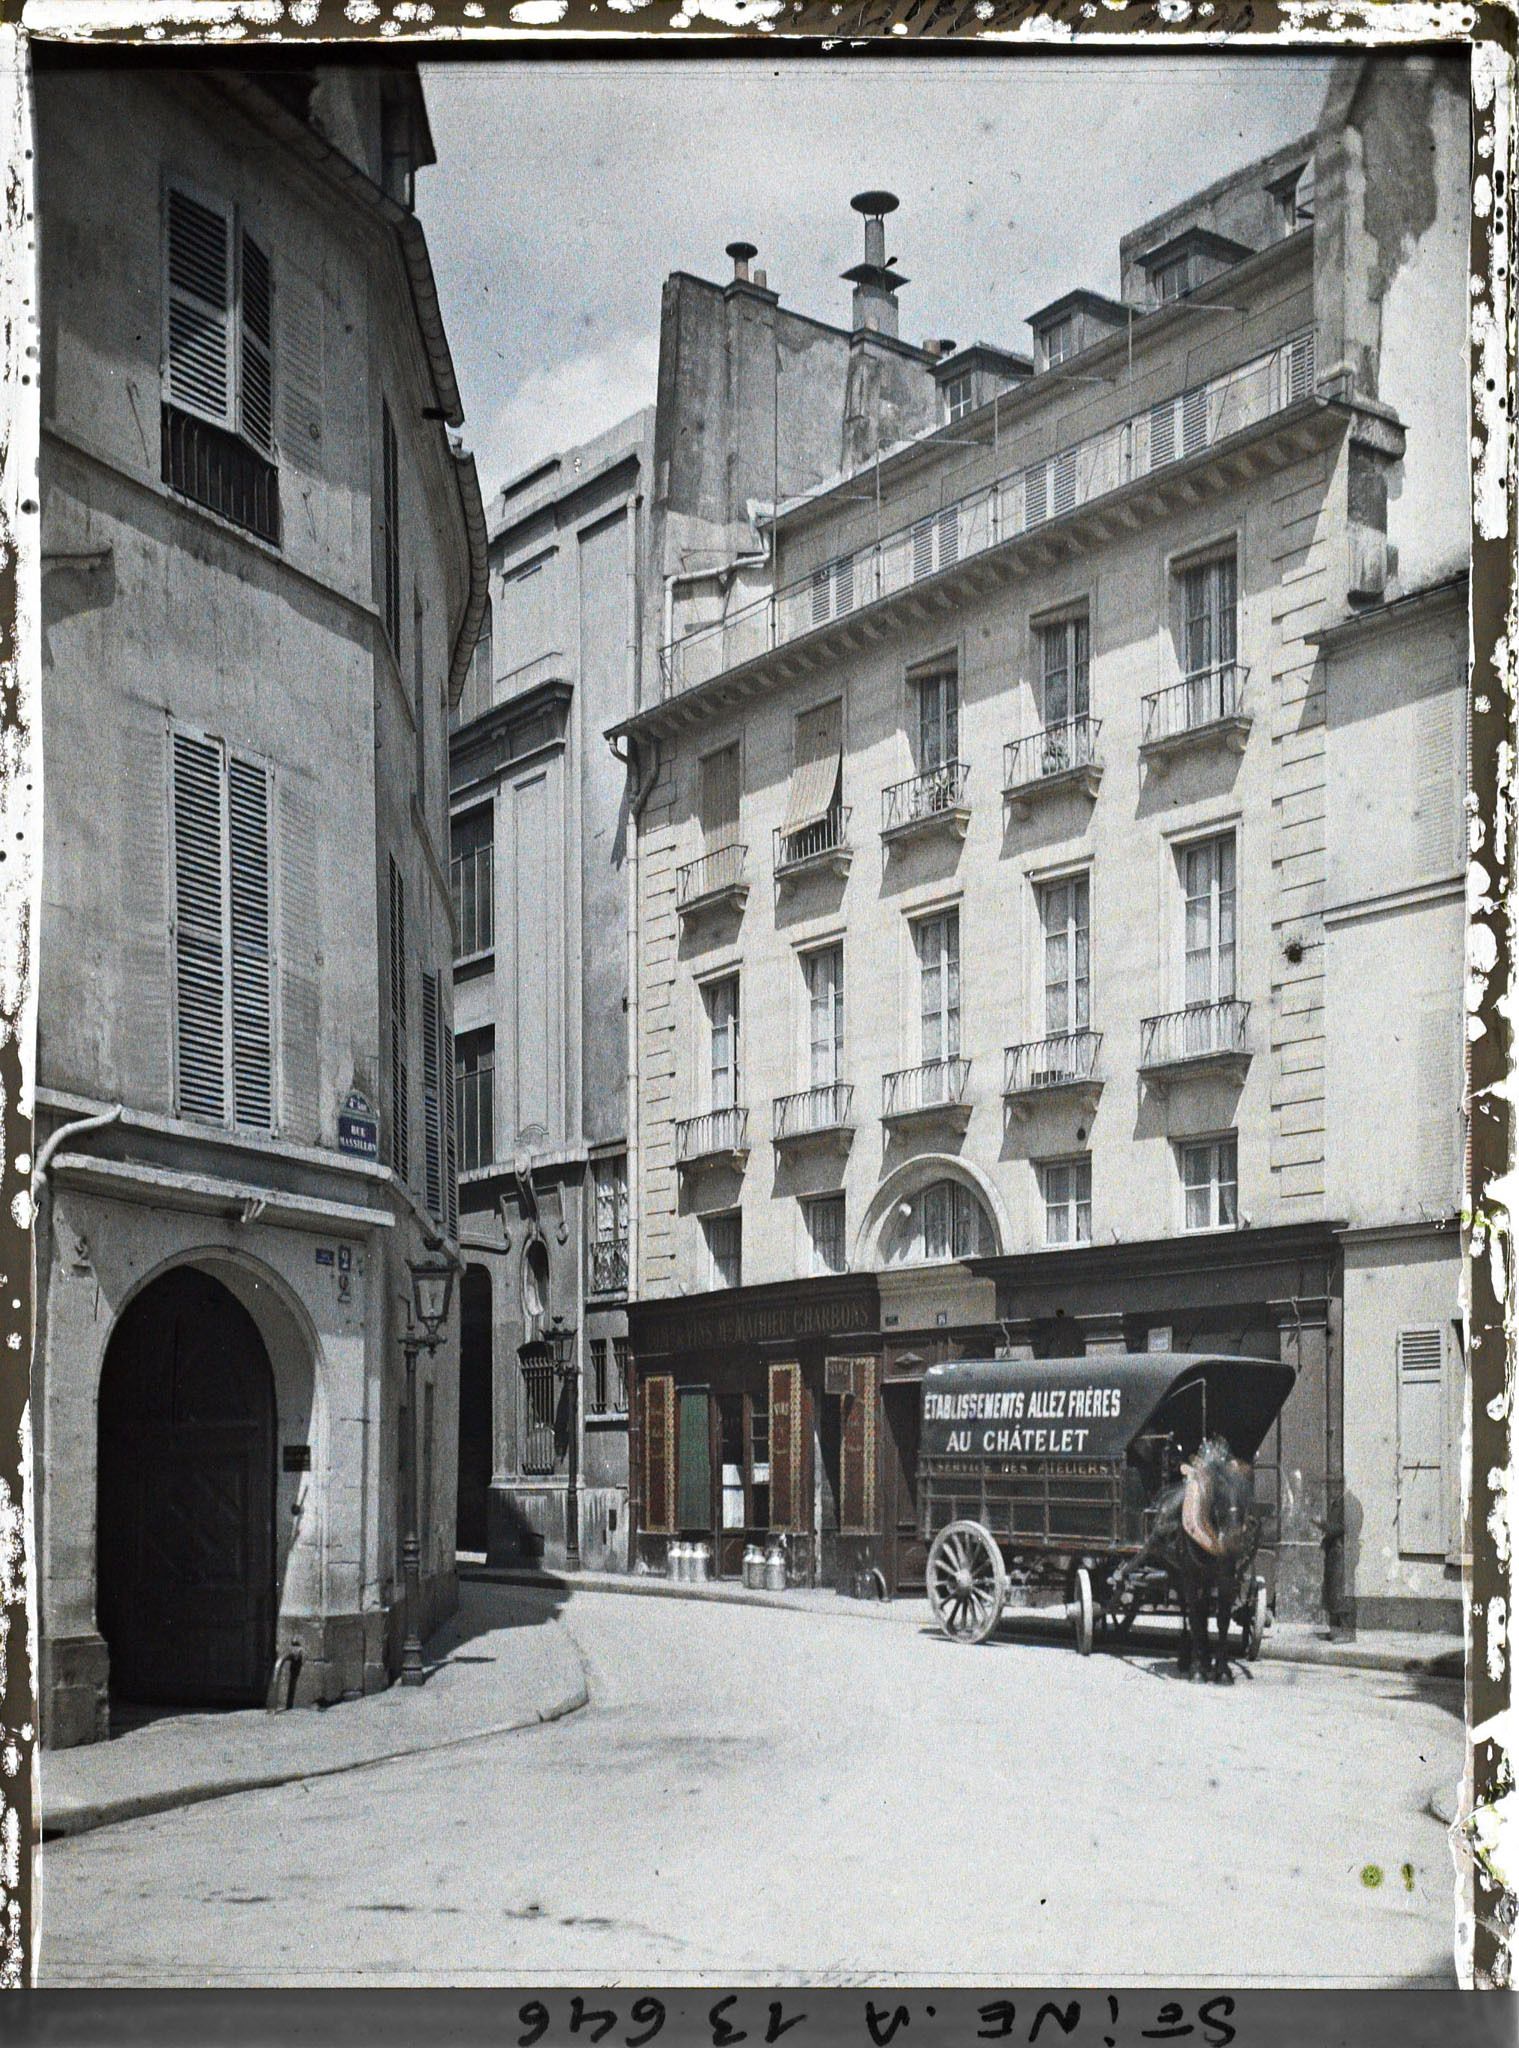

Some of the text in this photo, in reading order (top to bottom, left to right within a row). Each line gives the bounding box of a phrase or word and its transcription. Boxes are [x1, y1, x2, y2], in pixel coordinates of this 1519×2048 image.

[351, 1125, 365, 1137] RUE
[793, 1302, 869, 1334] CHARBONS
[923, 1391, 1025, 1420] ÉTABLISSEMENTS
[1027, 1391, 1067, 1418] ALLEZ
[945, 1431, 972, 1452] AU
[1038, 1460, 1108, 1475] ATELIERS
